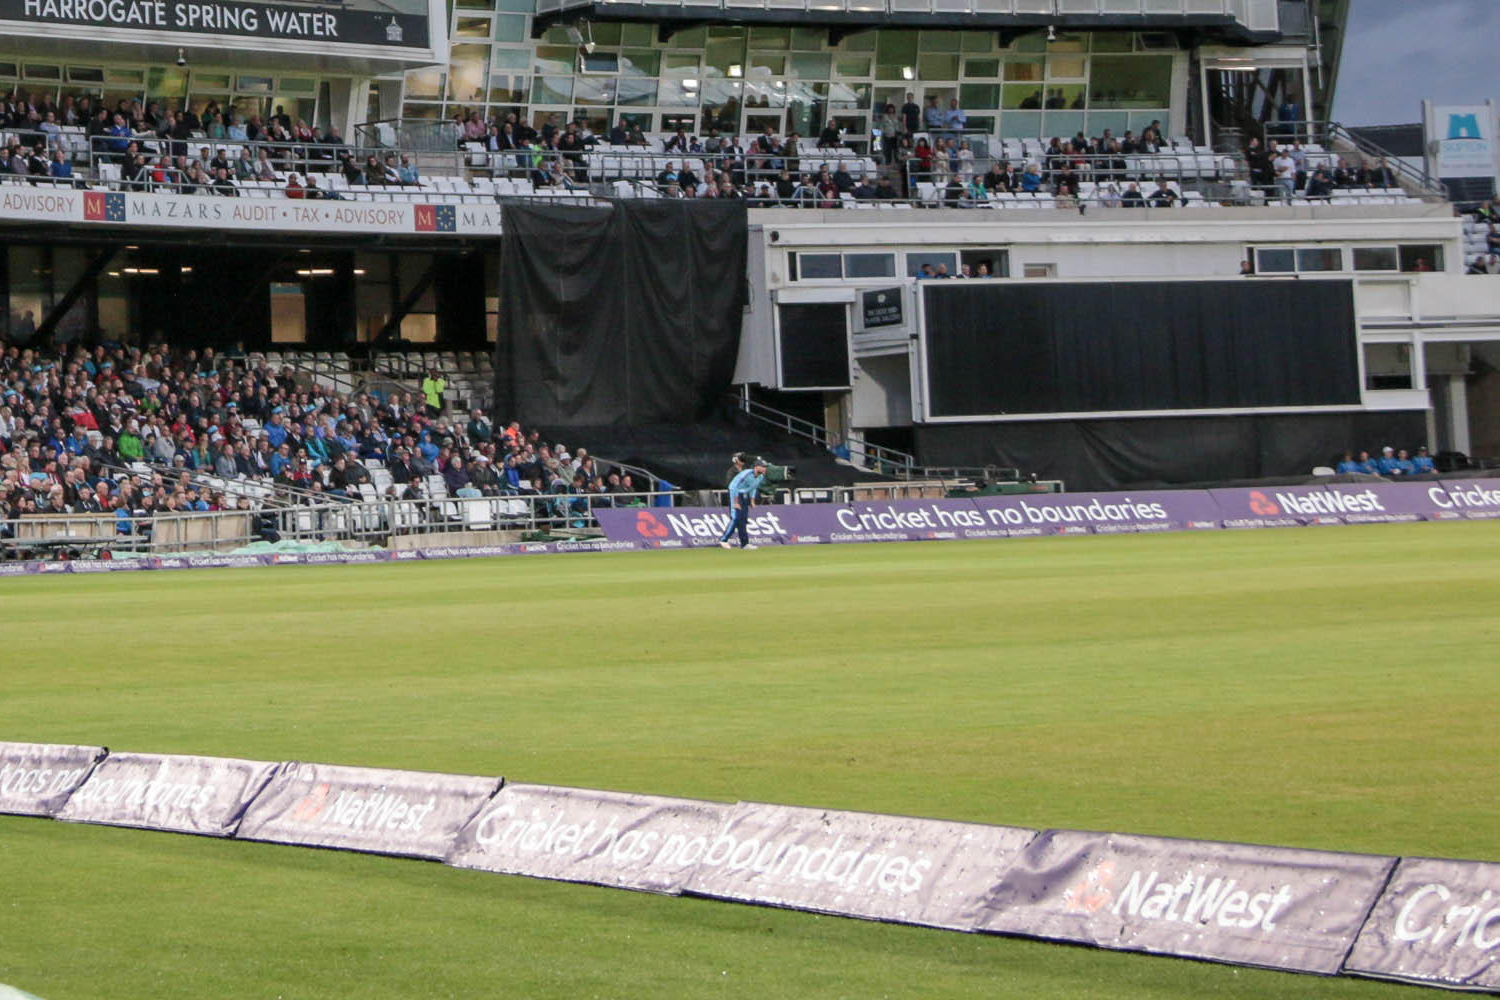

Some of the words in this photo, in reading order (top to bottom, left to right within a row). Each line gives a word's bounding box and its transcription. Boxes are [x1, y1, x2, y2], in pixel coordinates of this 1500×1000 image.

[176, 3, 258, 31] SPRING
[267, 8, 338, 37] WATER
[3, 193, 75, 213] ADVISORY
[86, 198, 101, 215] M
[132, 199, 222, 221] MAZARS
[233, 205, 277, 222] AUDIT
[294, 208, 320, 224] TAX
[334, 208, 405, 226] ADVISORY
[418, 209, 432, 226] M
[837, 504, 939, 531] Cricket
[936, 503, 985, 527] has
[988, 508, 1024, 525] no
[1020, 497, 1167, 524] boundaries
[1275, 489, 1385, 515] NatWest
[4, 757, 48, 795] has
[52, 771, 80, 795] no
[79, 760, 216, 811] boundaries
[325, 791, 435, 832] NatWest
[476, 804, 598, 860] Cricket
[597, 818, 651, 864] has
[659, 832, 703, 868] no
[703, 821, 932, 894] boundaries
[1112, 870, 1293, 934] NatWest
